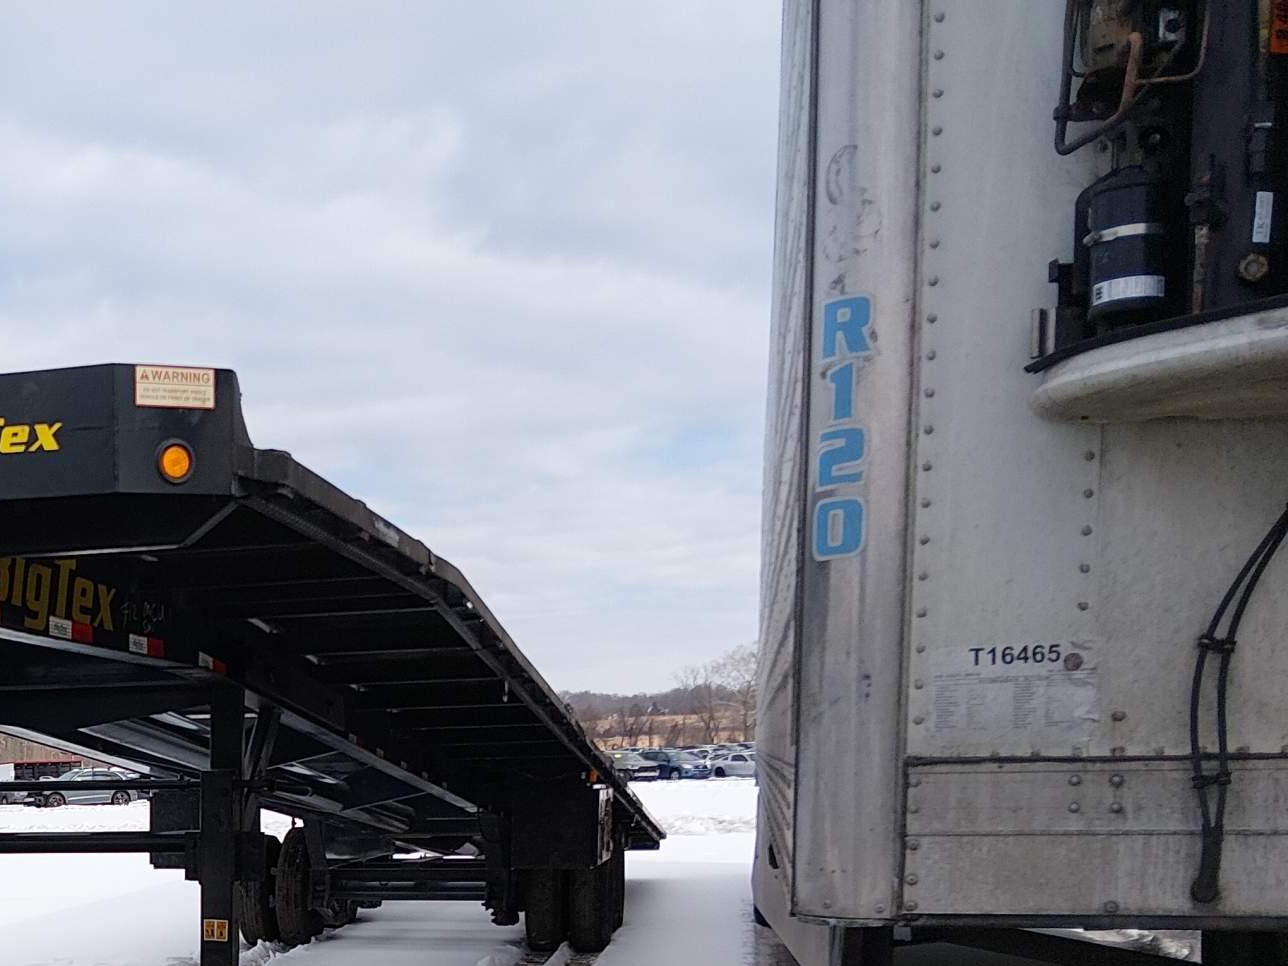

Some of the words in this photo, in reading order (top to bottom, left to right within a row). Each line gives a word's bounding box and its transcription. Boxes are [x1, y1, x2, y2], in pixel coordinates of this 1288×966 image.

[151, 370, 210, 384] WARNING
[815, 294, 875, 561] R120
[968, 643, 1062, 667] T16465
